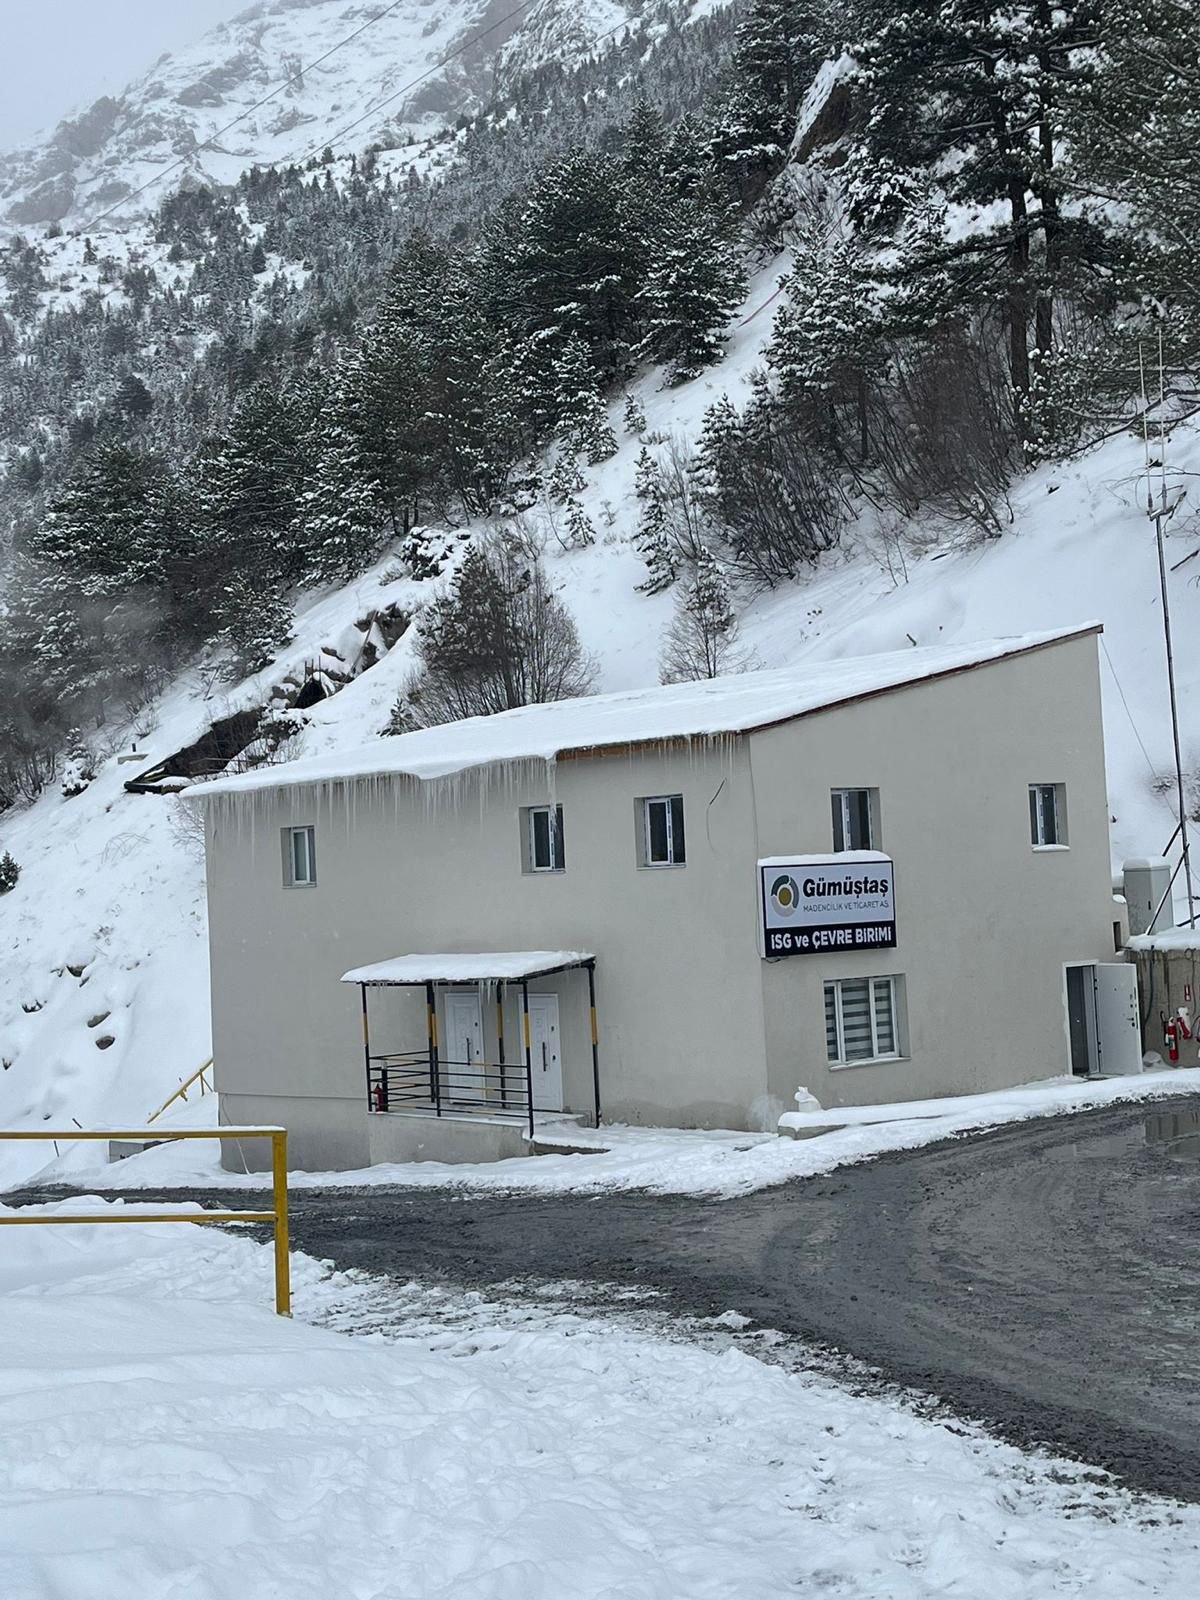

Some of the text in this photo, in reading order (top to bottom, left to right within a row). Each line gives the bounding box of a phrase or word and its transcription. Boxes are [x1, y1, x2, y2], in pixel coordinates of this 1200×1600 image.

[802, 876, 889, 899] Gümüştaş
[844, 902, 852, 910] VE
[794, 935, 809, 948] ve
[812, 928, 853, 950] ÇEVRE
